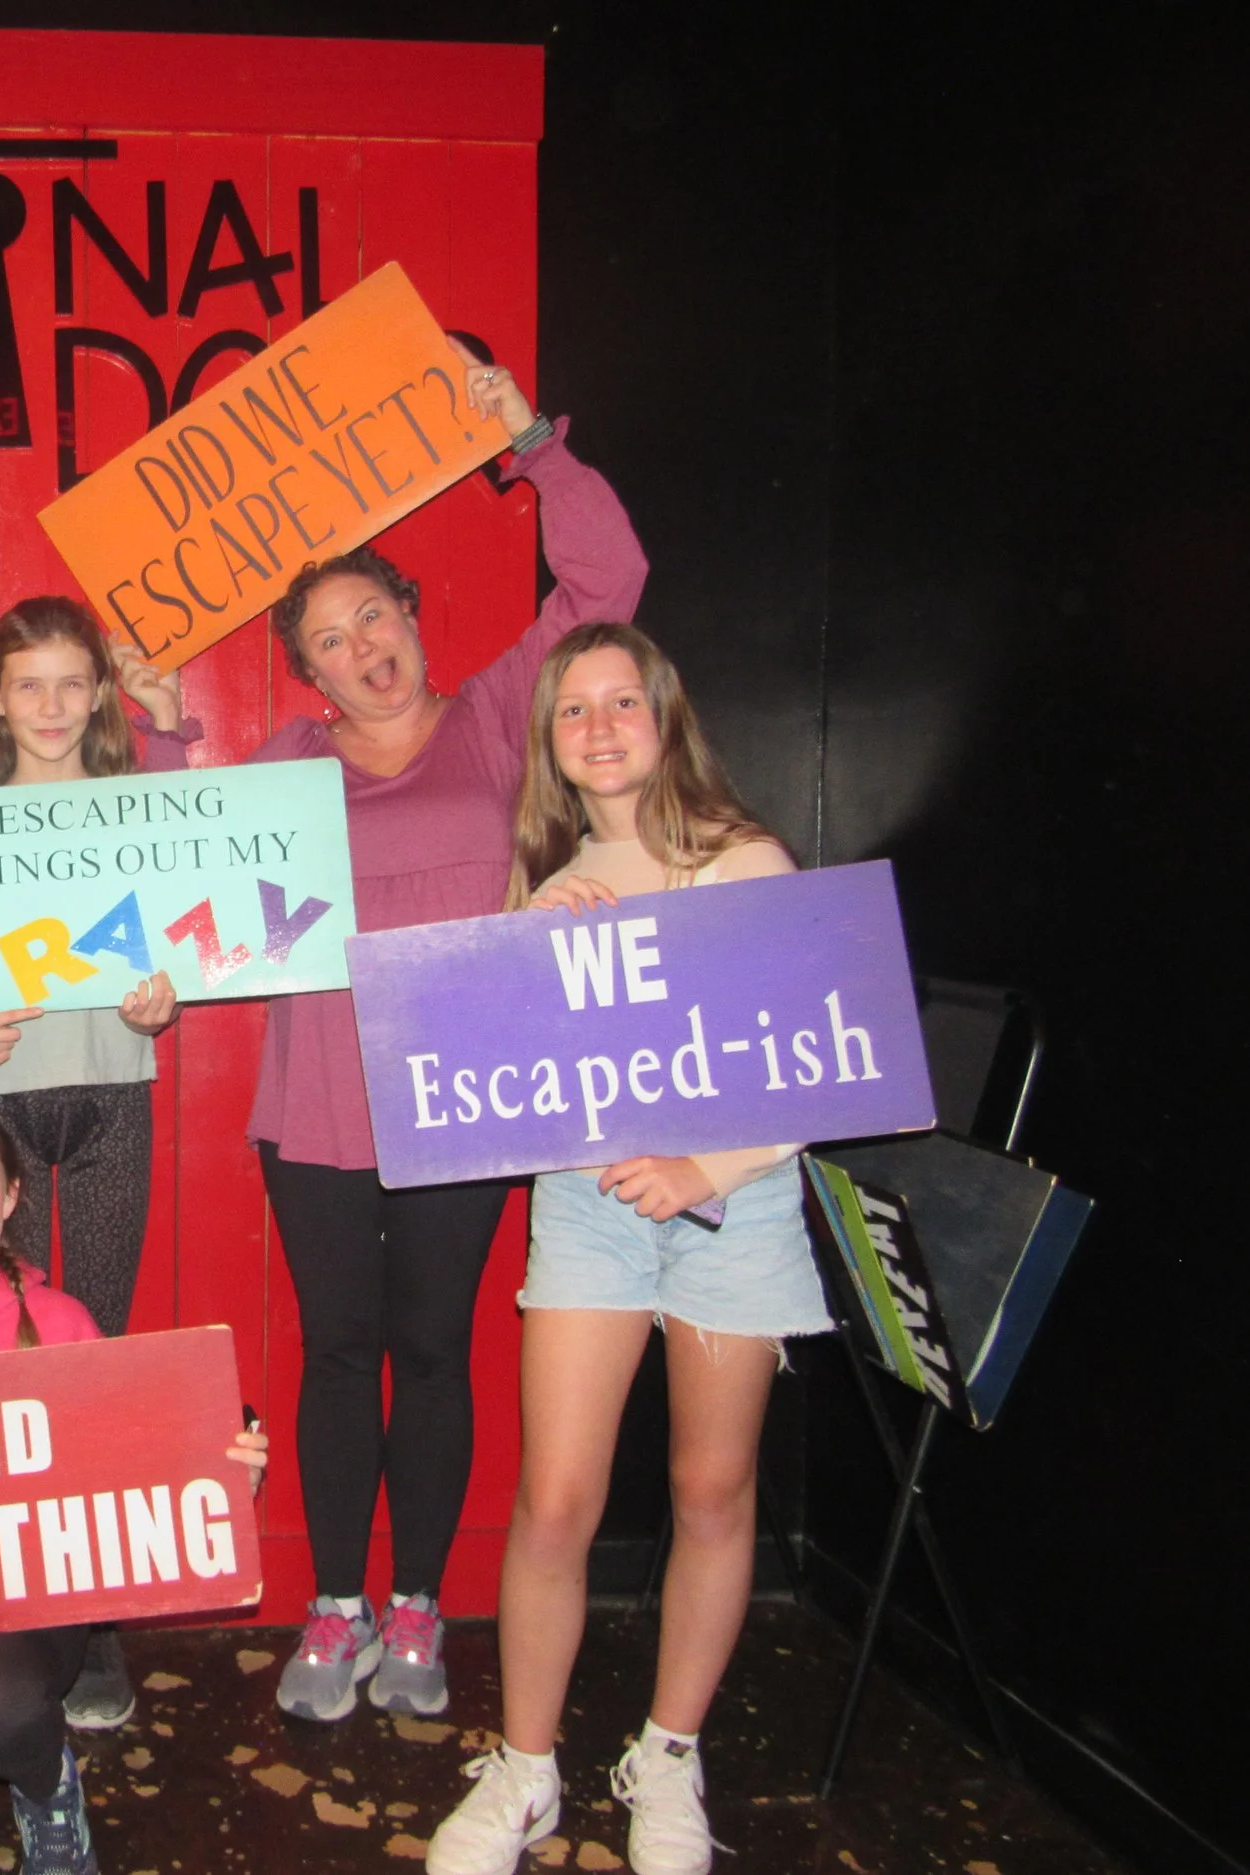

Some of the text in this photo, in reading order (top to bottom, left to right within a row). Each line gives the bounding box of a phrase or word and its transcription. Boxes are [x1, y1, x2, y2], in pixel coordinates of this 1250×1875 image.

[106, 465, 336, 660] ESCAPE
[309, 367, 474, 513] YET?
[134, 425, 235, 533] DID
[219, 345, 348, 466] WE
[116, 837, 209, 873] OUT
[227, 830, 299, 866] MY
[550, 917, 669, 1011] WE
[405, 989, 883, 1141] Escaped-ish
